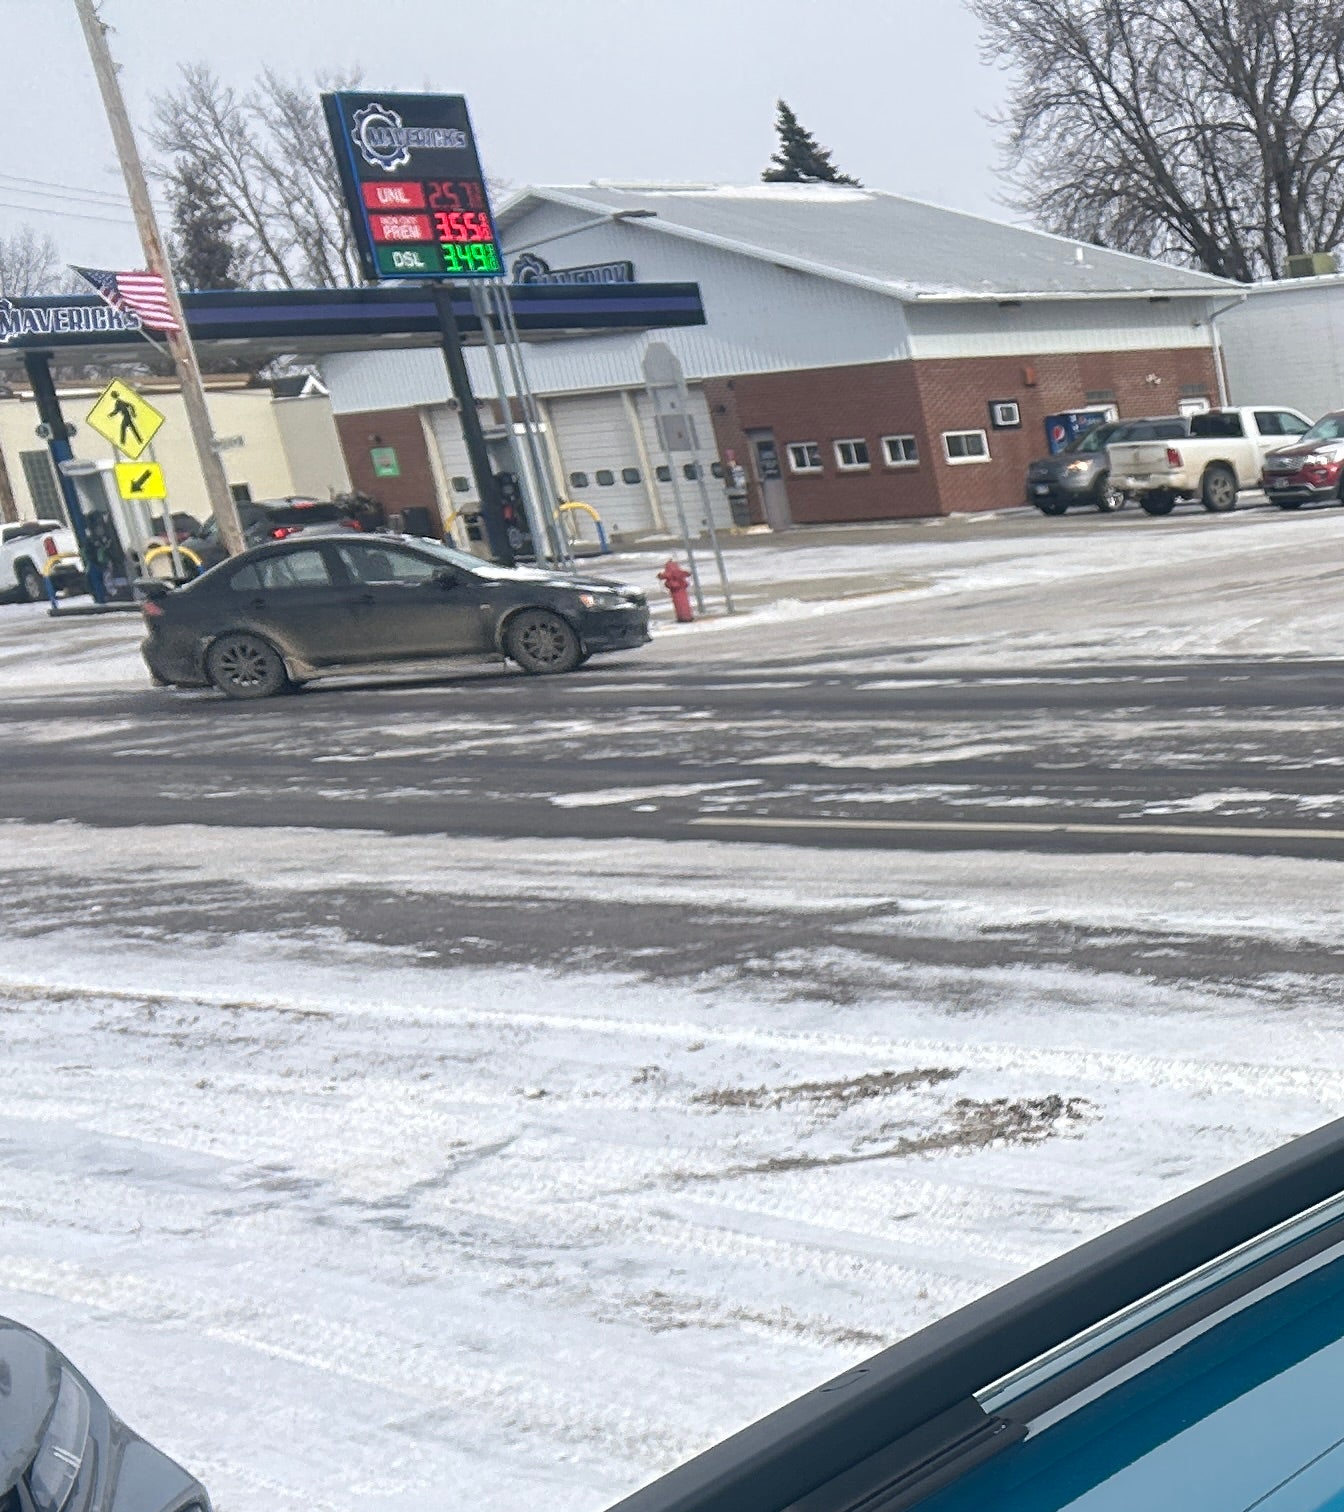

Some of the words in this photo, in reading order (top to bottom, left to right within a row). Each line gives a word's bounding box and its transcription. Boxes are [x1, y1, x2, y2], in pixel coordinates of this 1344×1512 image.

[376, 187, 411, 204] UNL
[391, 251, 425, 268] DSL
[0, 305, 143, 334] MAVERICKS
